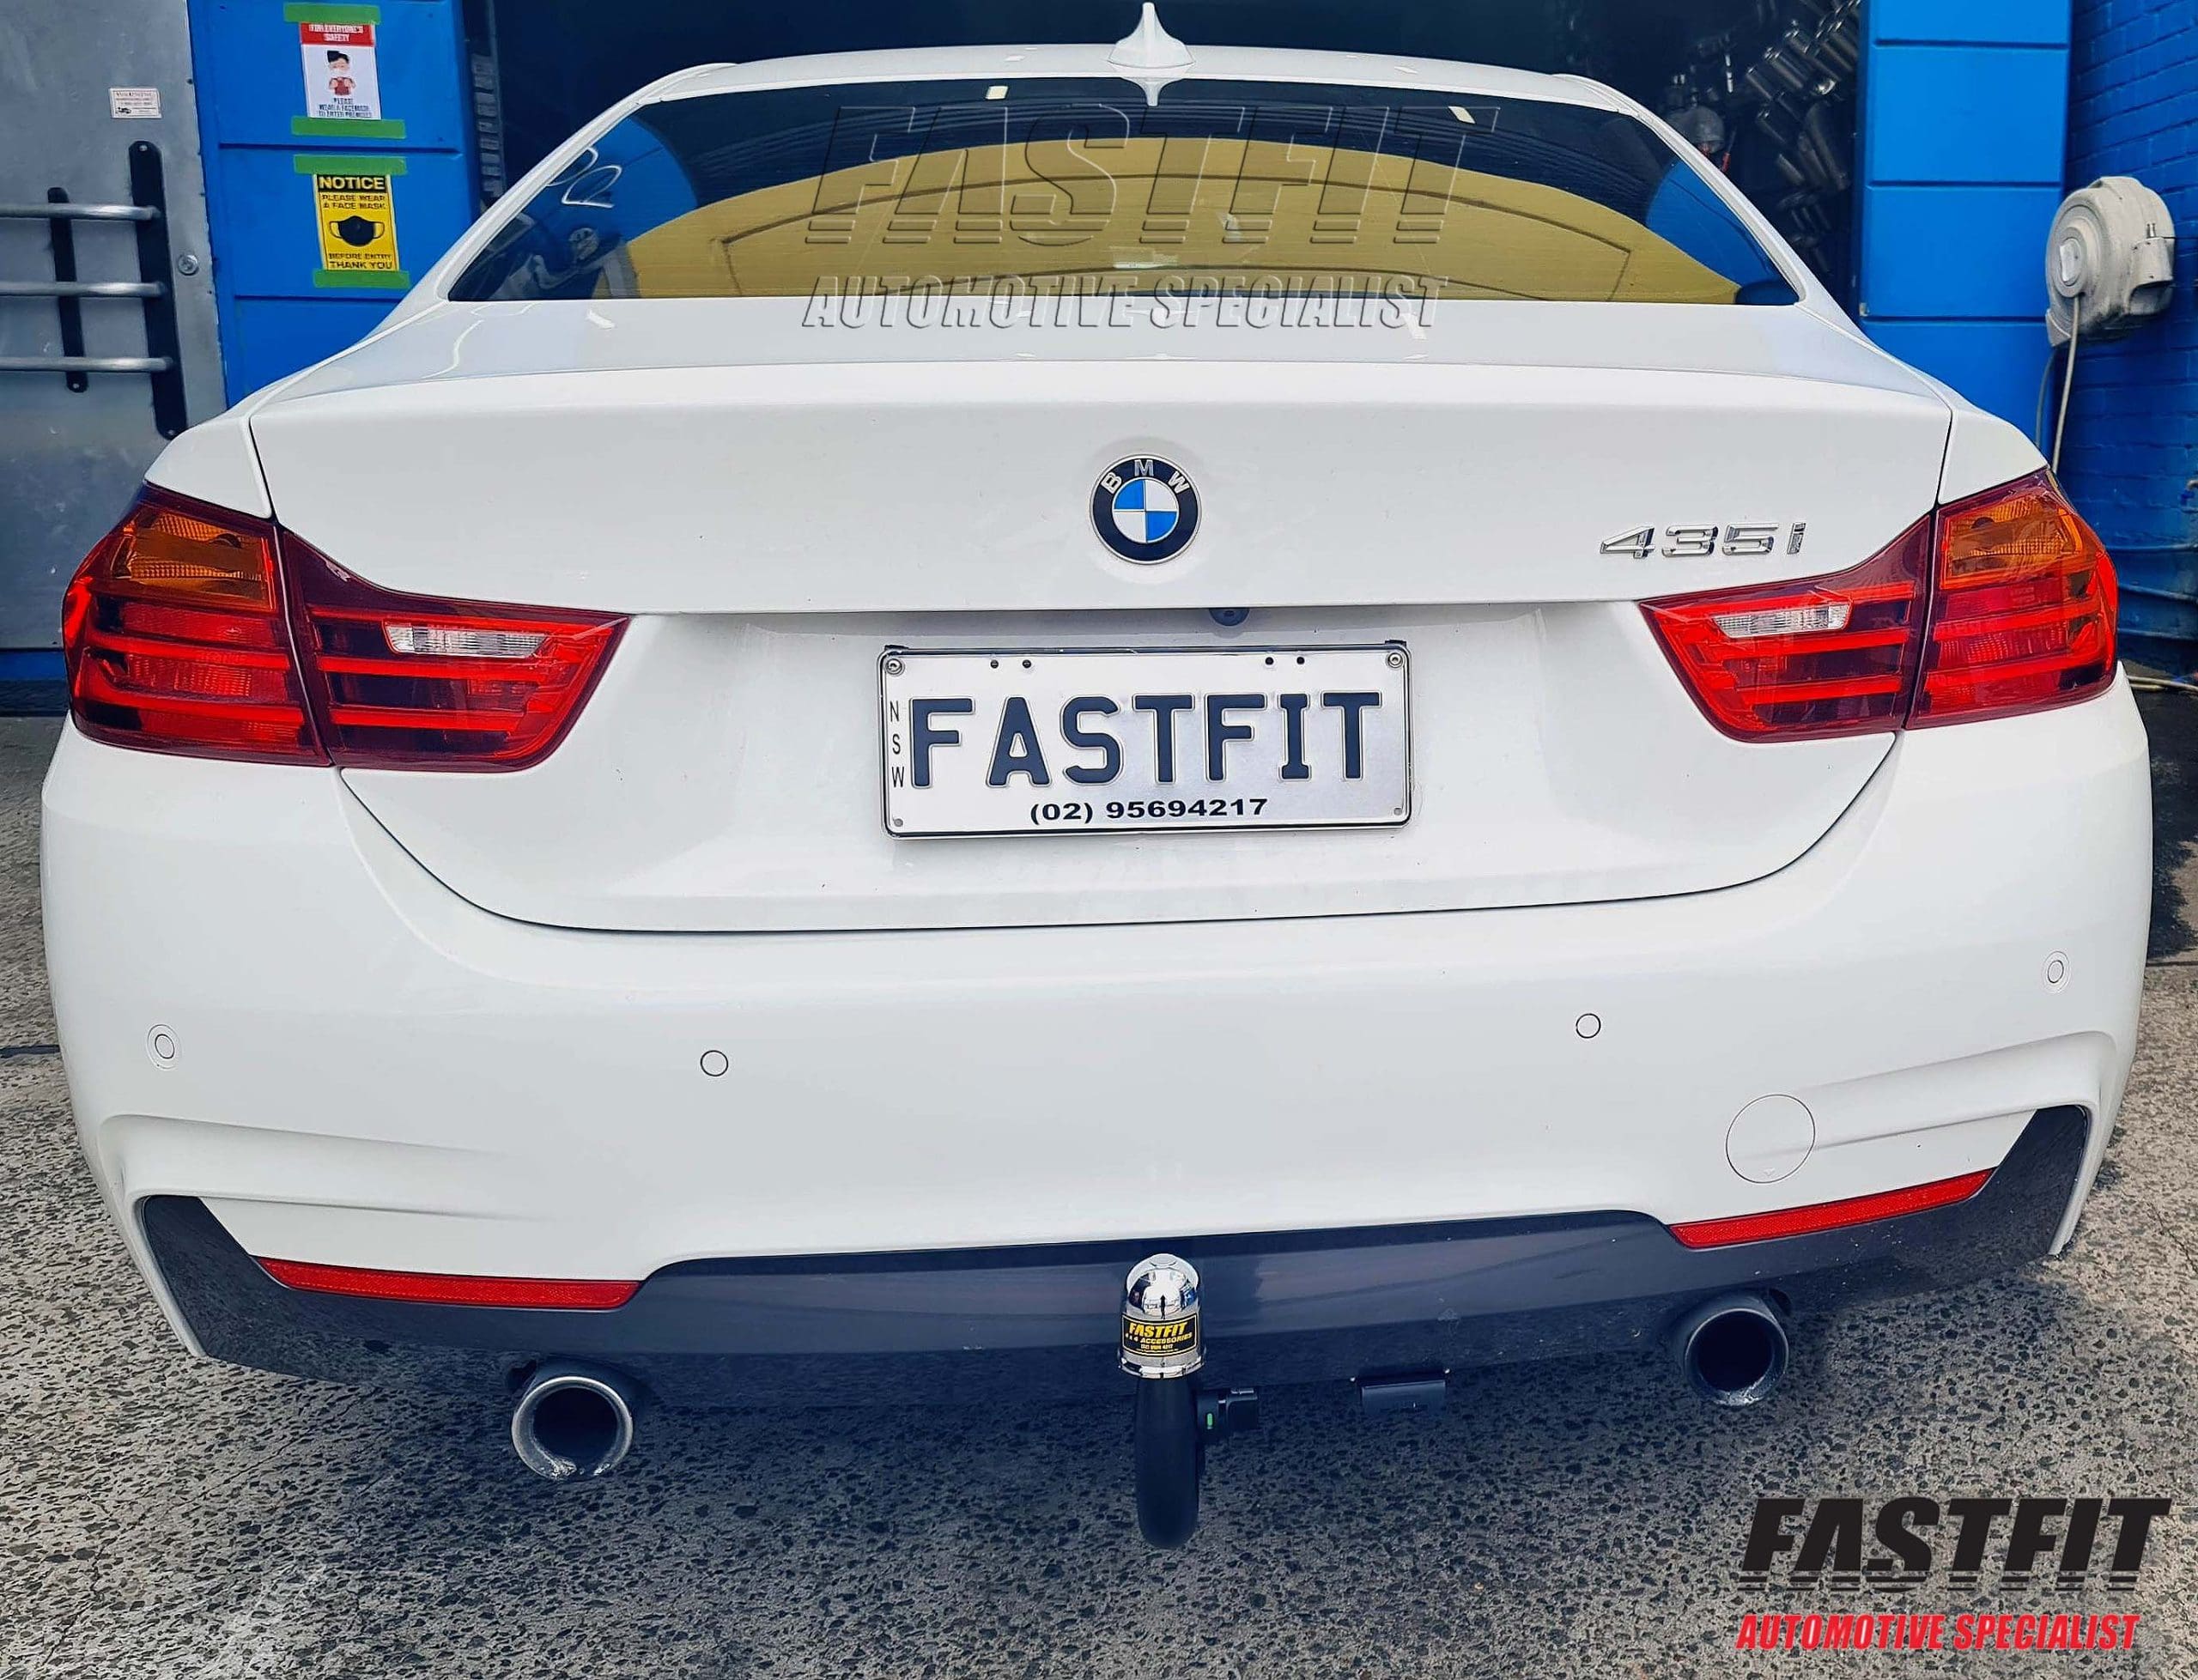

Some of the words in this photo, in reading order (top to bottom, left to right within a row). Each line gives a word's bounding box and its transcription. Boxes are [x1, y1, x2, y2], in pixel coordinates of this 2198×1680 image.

[319, 176, 386, 190] NOTICE
[1101, 458, 1191, 494] BMW
[1600, 522, 1806, 558] 435i
[908, 690, 1382, 788] FASTFIT
[1030, 803, 1093, 824] (02)
[1106, 798, 1268, 818] 95694217
[1129, 1322, 1187, 1337] FASTFIT
